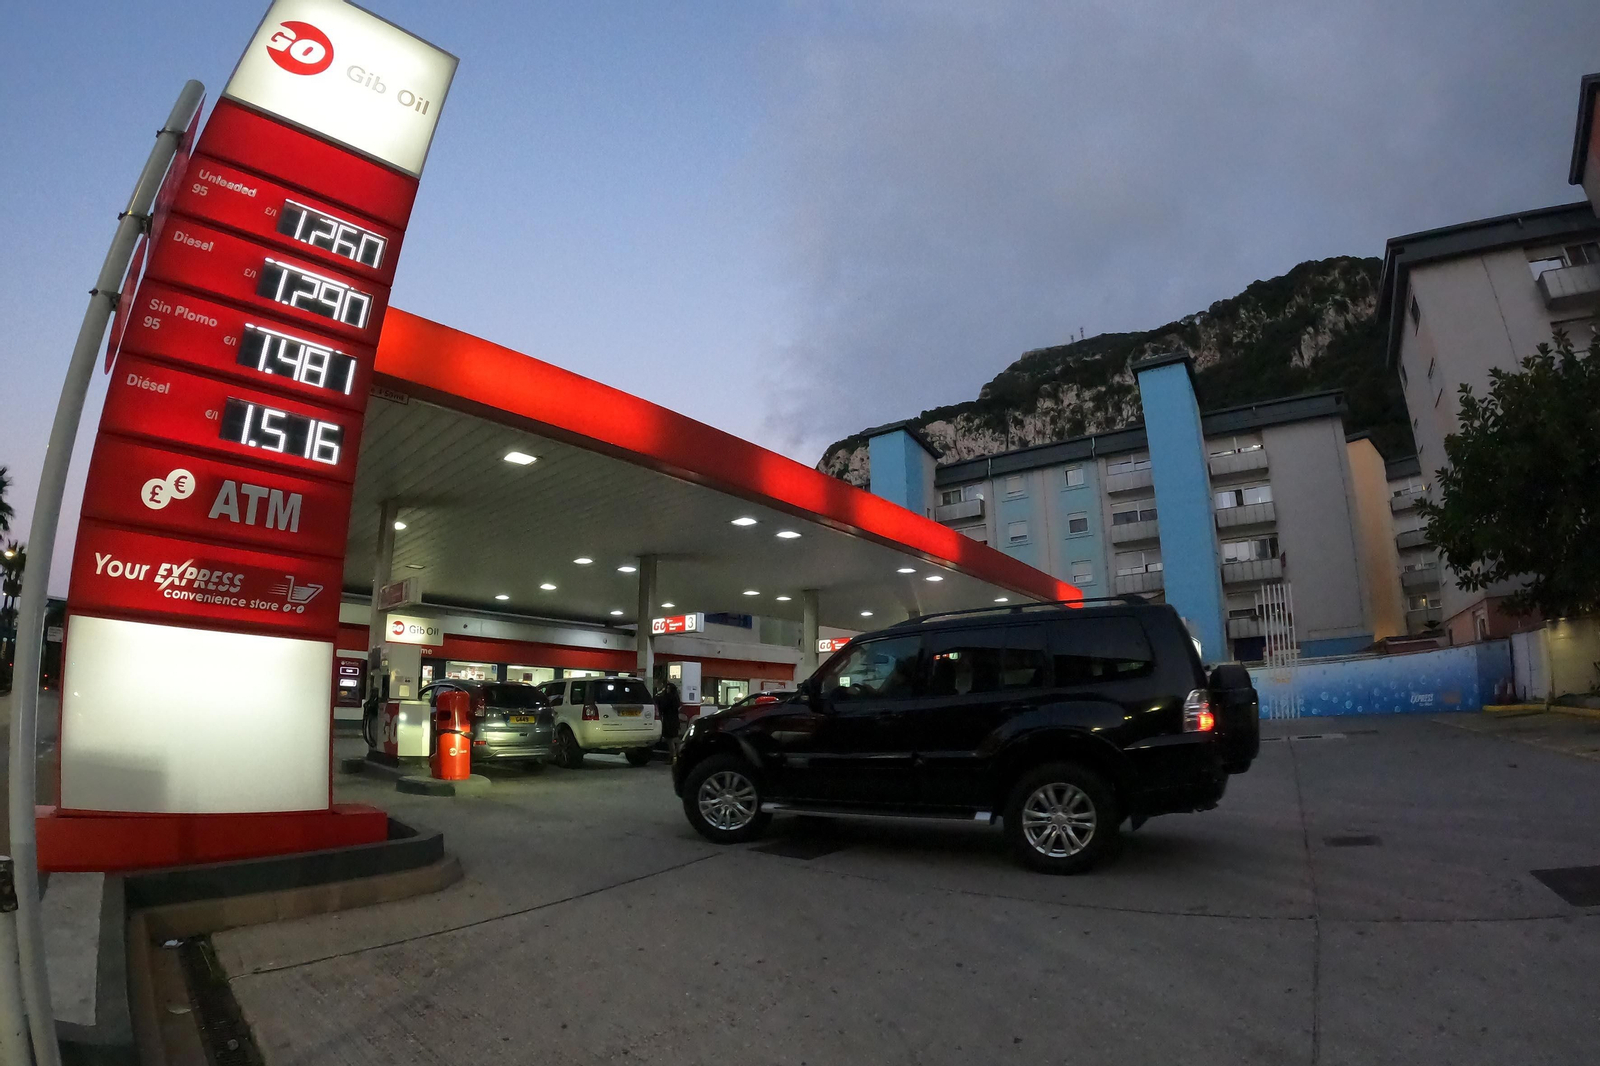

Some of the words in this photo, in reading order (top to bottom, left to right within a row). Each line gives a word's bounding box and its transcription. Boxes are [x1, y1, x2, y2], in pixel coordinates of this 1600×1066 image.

[266, 25, 329, 69] GO
[346, 65, 387, 94] Gib
[397, 89, 430, 115] Oil
[192, 183, 208, 196] 95
[199, 169, 257, 197] Unleaded
[173, 230, 214, 252] Diesel
[294, 210, 384, 269] 1.260
[149, 299, 172, 314] Sin
[174, 305, 218, 327] Plomo
[275, 269, 370, 329] 1.290
[143, 315, 161, 330] 95
[258, 334, 356, 395] 1.481
[126, 373, 171, 394] Diésel
[241, 404, 339, 465] 1.516
[208, 479, 302, 533] ATM
[95, 552, 150, 581] Your
[153, 559, 244, 593] EXPRESS
[164, 588, 246, 607] convenience
[249, 598, 279, 611] store
[409, 624, 425, 635] Gib
[426, 627, 439, 636] Oil
[687, 616, 694, 629] 3
